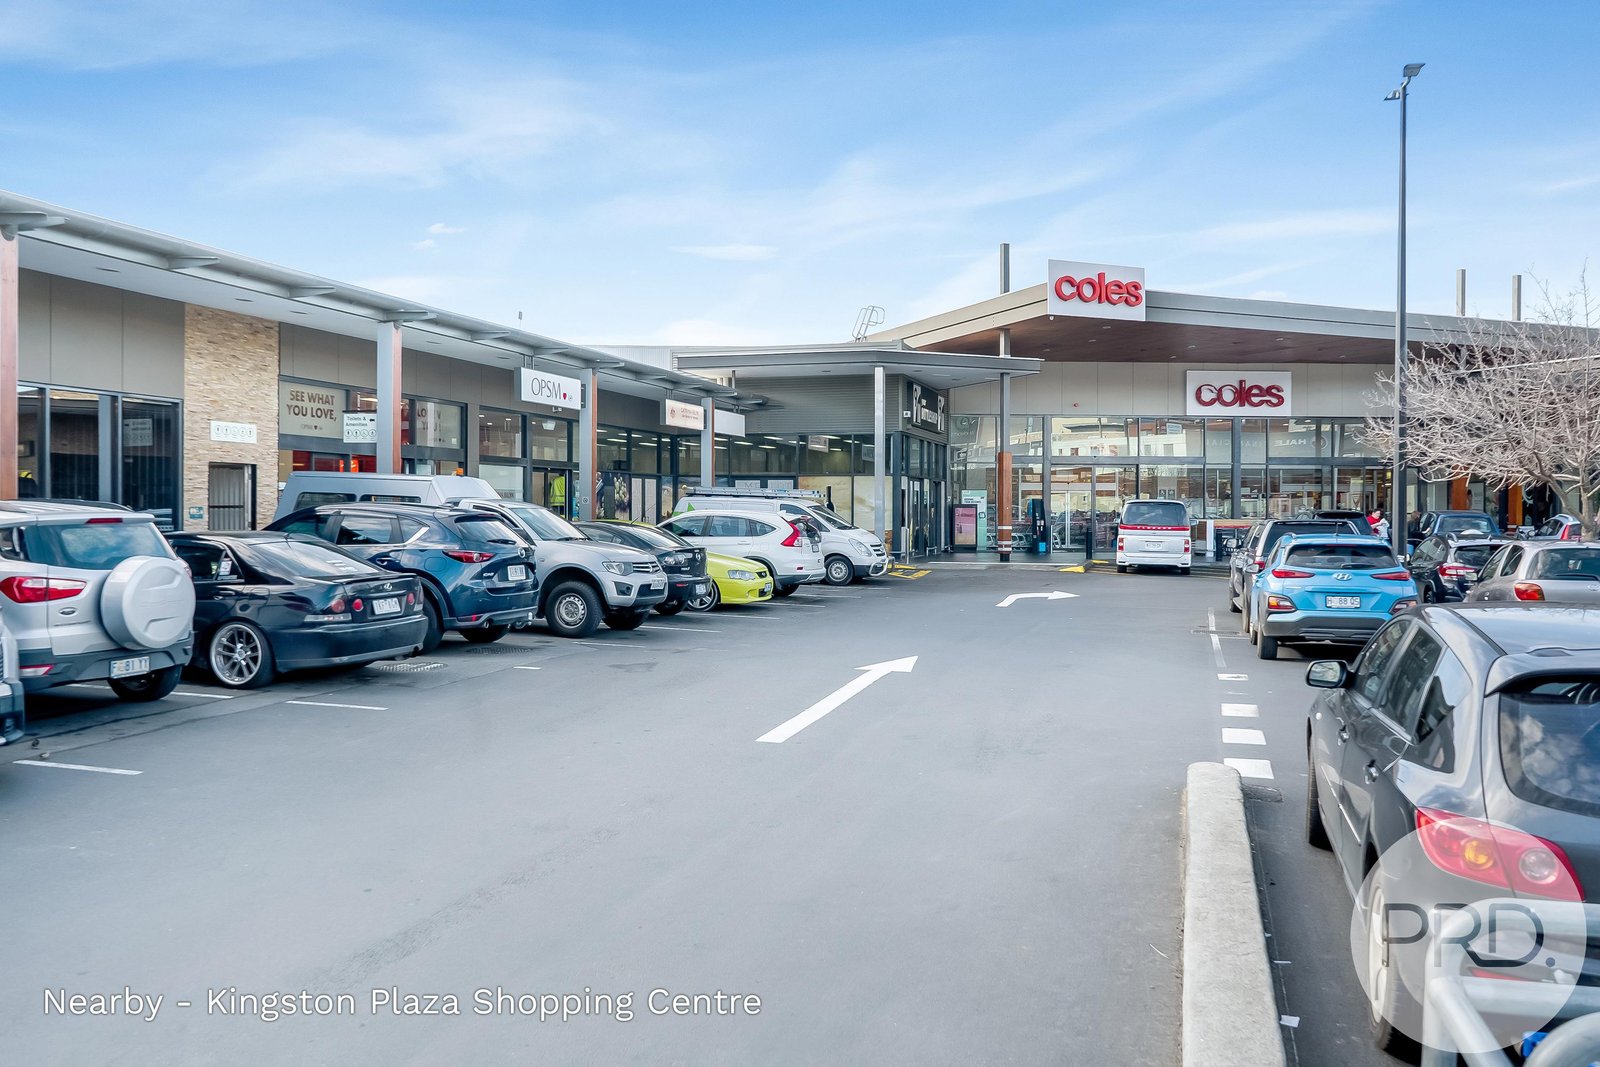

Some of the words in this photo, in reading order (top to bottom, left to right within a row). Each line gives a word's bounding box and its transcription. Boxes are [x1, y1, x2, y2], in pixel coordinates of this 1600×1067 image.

[1054, 272, 1143, 307] coles
[290, 389, 306, 402] SEE
[307, 391, 336, 406] WHAT
[531, 377, 562, 400] OPSM
[1195, 379, 1285, 407] coles
[286, 403, 309, 418] YOU
[310, 405, 338, 422] LOVE,
